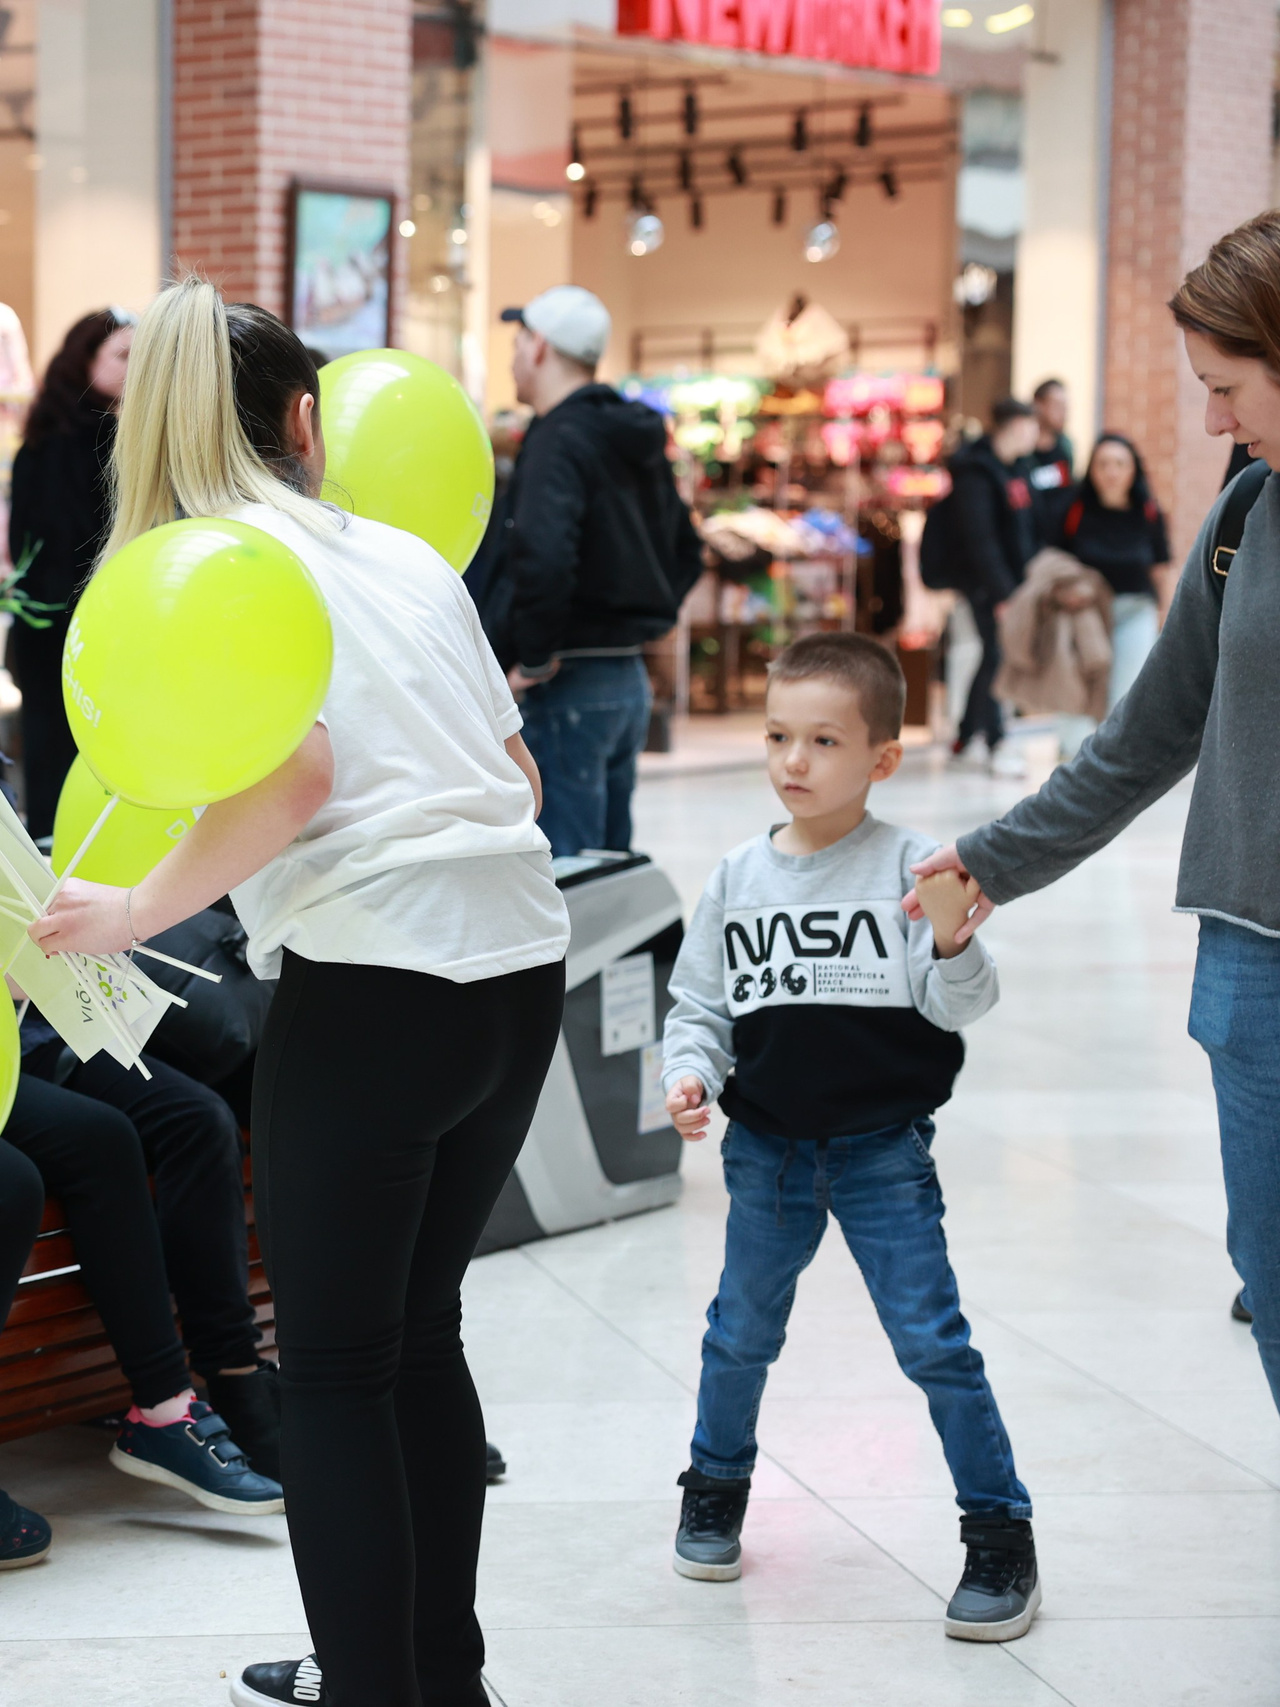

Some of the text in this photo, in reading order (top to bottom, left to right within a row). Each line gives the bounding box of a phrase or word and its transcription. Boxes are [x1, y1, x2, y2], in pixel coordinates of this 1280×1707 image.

[724, 910, 889, 970] NASA
[818, 964, 861, 972] NATIONAL
[818, 972, 877, 980] AERONAUTICS
[818, 987, 890, 995] ADMINISTRATION
